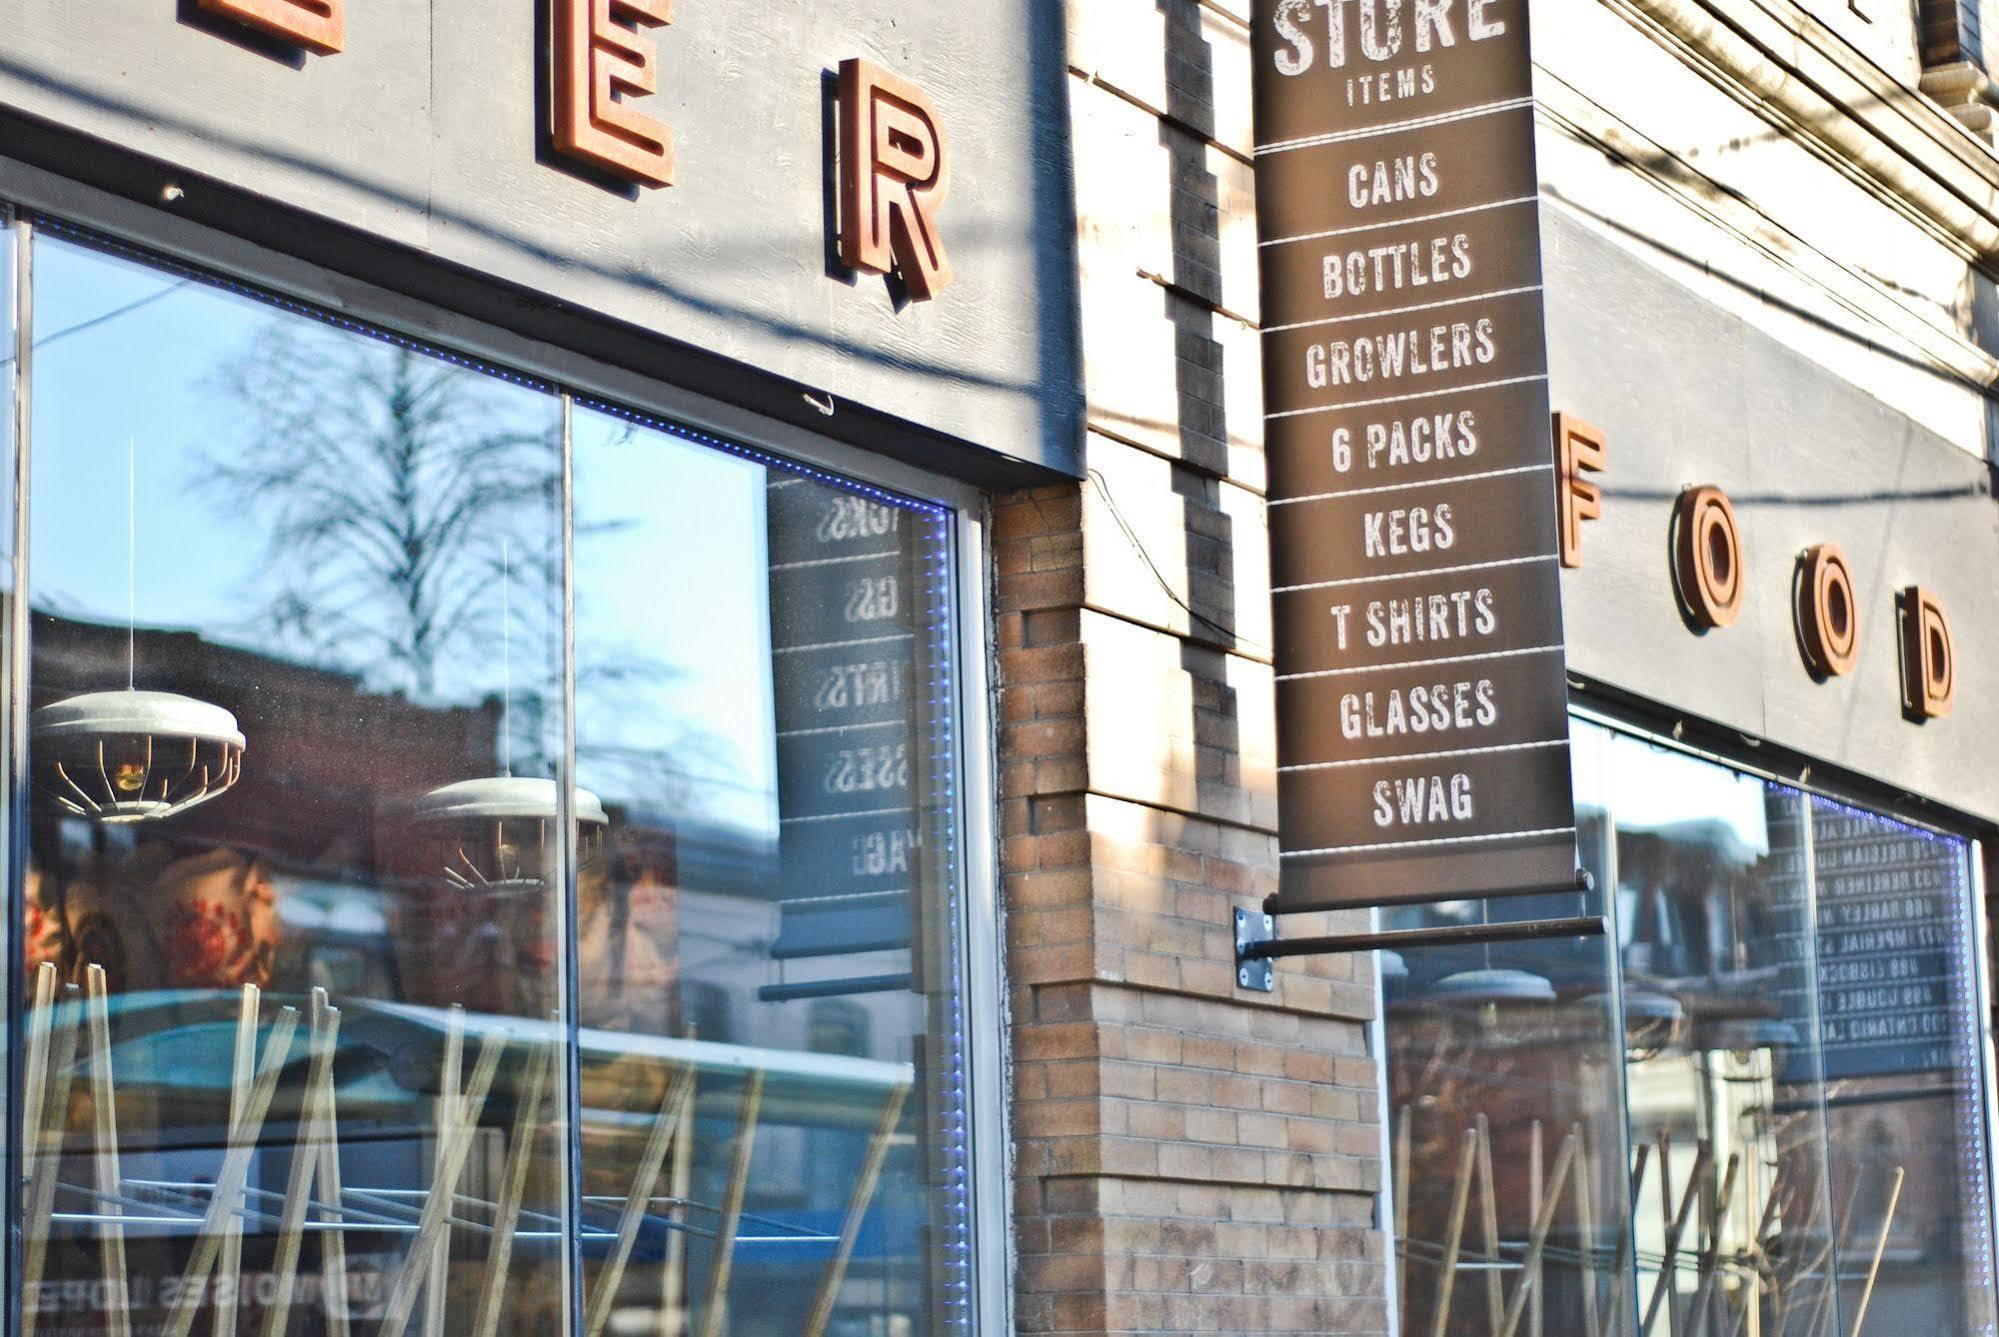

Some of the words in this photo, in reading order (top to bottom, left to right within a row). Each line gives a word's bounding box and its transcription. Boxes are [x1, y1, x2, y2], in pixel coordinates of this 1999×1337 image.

[1347, 64, 1435, 107] ITEMS
[1348, 152, 1438, 208] CANS
[1322, 233, 1472, 299] BOTTLES
[1306, 318, 1495, 388] GROWLERS
[1332, 427, 1351, 473] 6
[1367, 410, 1477, 469] PACKS
[1364, 503, 1454, 557] KEGS
[1551, 411, 1957, 718] FOOD
[1330, 605, 1350, 650] T
[1366, 588, 1496, 648] SHIRTS
[1340, 679, 1496, 739] GLASSES
[1373, 773, 1472, 826] SWAG
